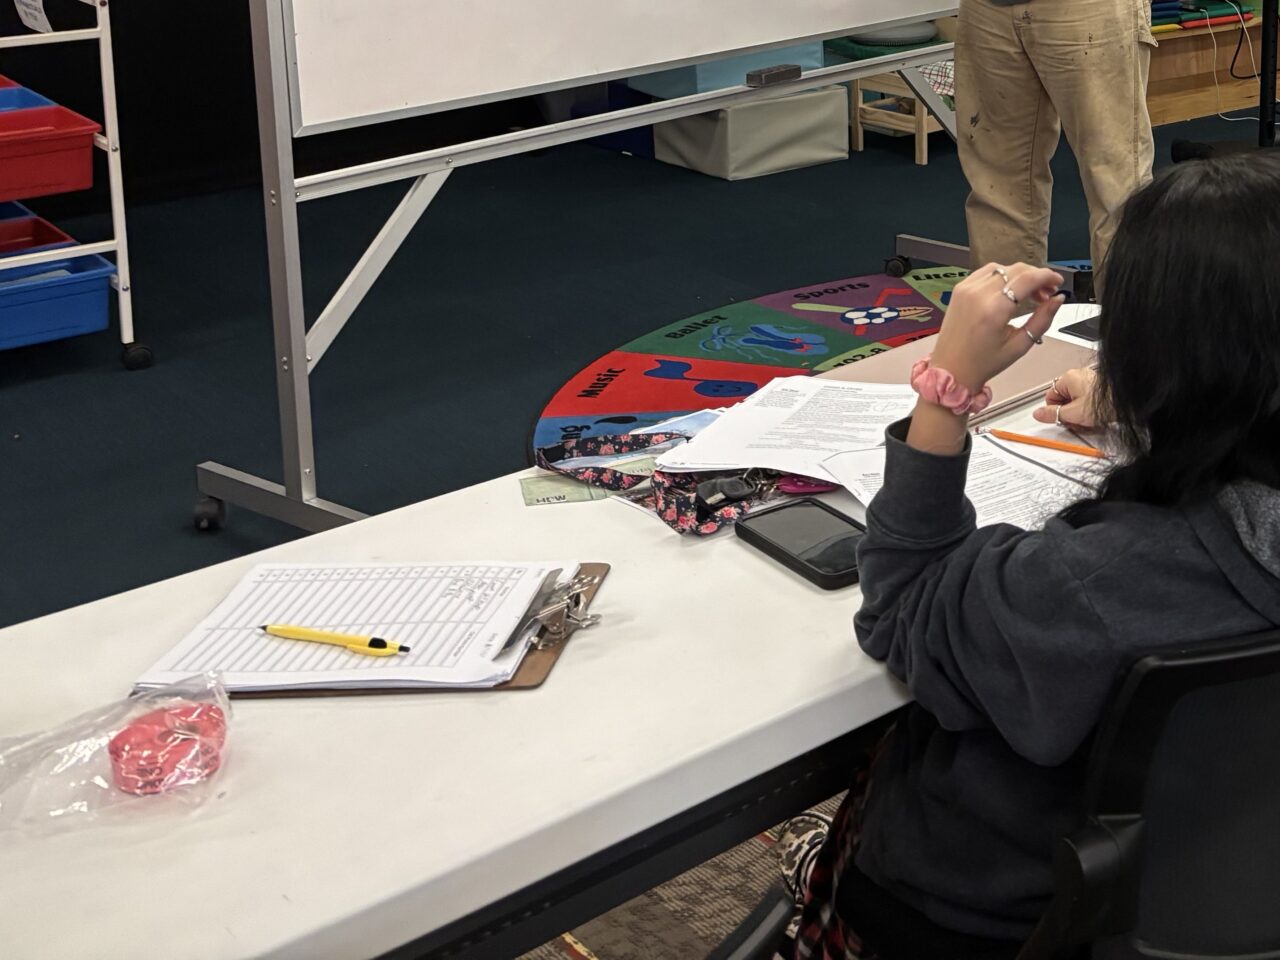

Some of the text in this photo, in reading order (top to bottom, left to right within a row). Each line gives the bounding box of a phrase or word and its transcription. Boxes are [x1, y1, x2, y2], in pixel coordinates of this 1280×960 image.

[911, 271, 968, 281] Liter
[792, 281, 871, 301] Sports
[664, 312, 728, 340] Ballet
[576, 367, 626, 399] Music
